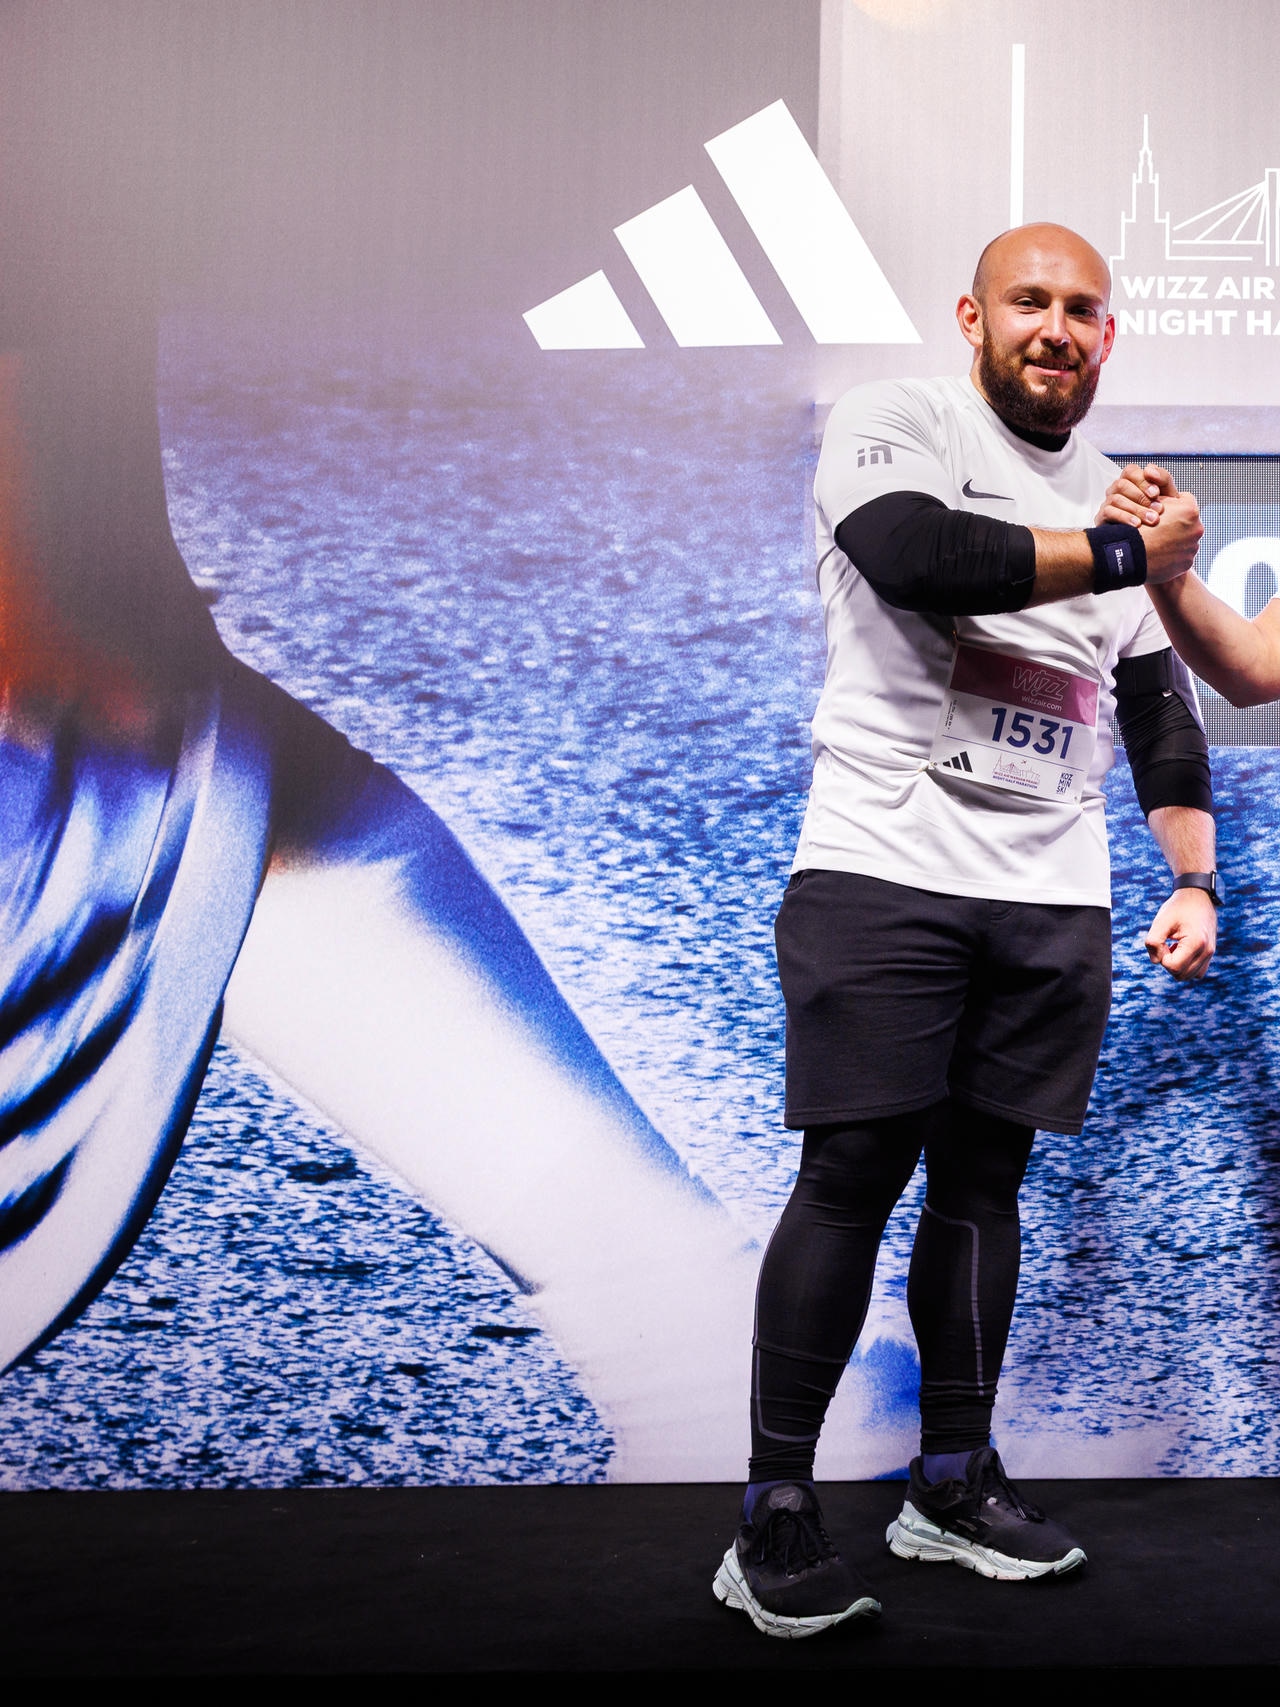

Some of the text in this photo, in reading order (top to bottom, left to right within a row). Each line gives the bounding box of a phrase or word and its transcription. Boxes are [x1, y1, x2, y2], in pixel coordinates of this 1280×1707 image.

[1120, 275, 1208, 299] WIZZ
[1214, 276, 1275, 300] AIR
[1119, 309, 1238, 336] NIGHT
[991, 707, 1074, 760] 1531
